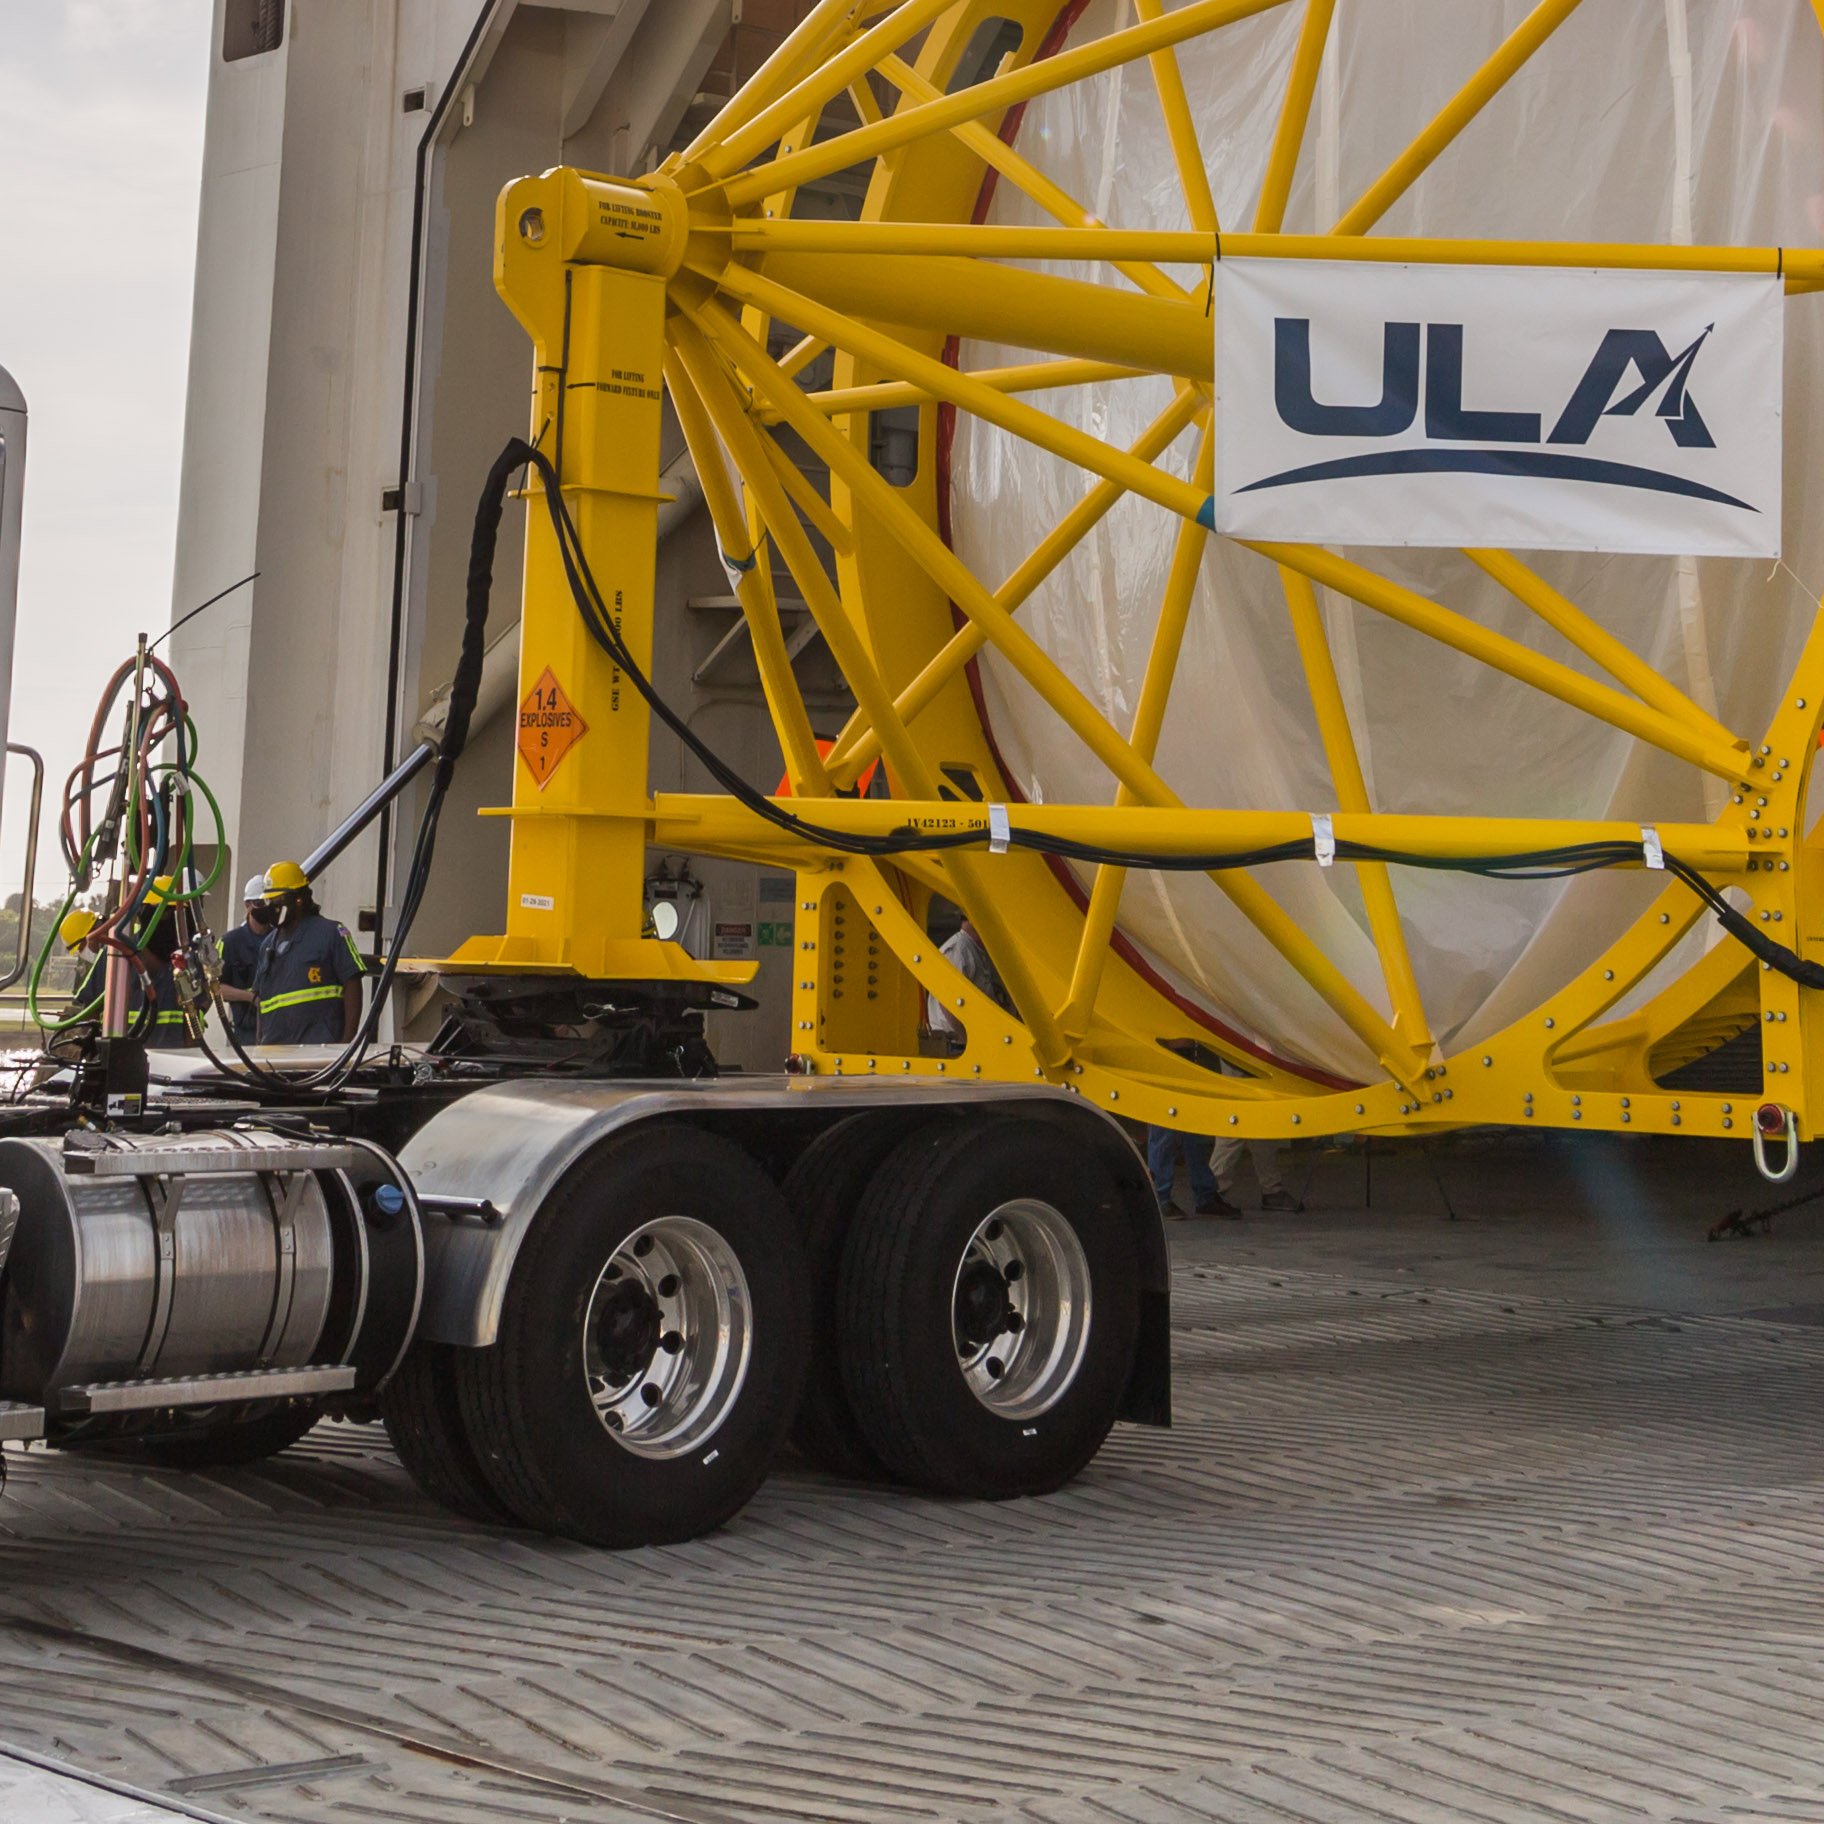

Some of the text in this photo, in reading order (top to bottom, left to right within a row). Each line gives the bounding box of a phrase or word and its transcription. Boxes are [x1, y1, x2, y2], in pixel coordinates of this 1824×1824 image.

[1274, 317, 1717, 448] ULA
[615, 590, 623, 612] LBS
[535, 688, 557, 711] 1.4
[611, 687, 620, 712] GSE
[520, 713, 572, 728] EXPLOSIVES
[540, 731, 549, 748] S
[540, 756, 545, 771] 1
